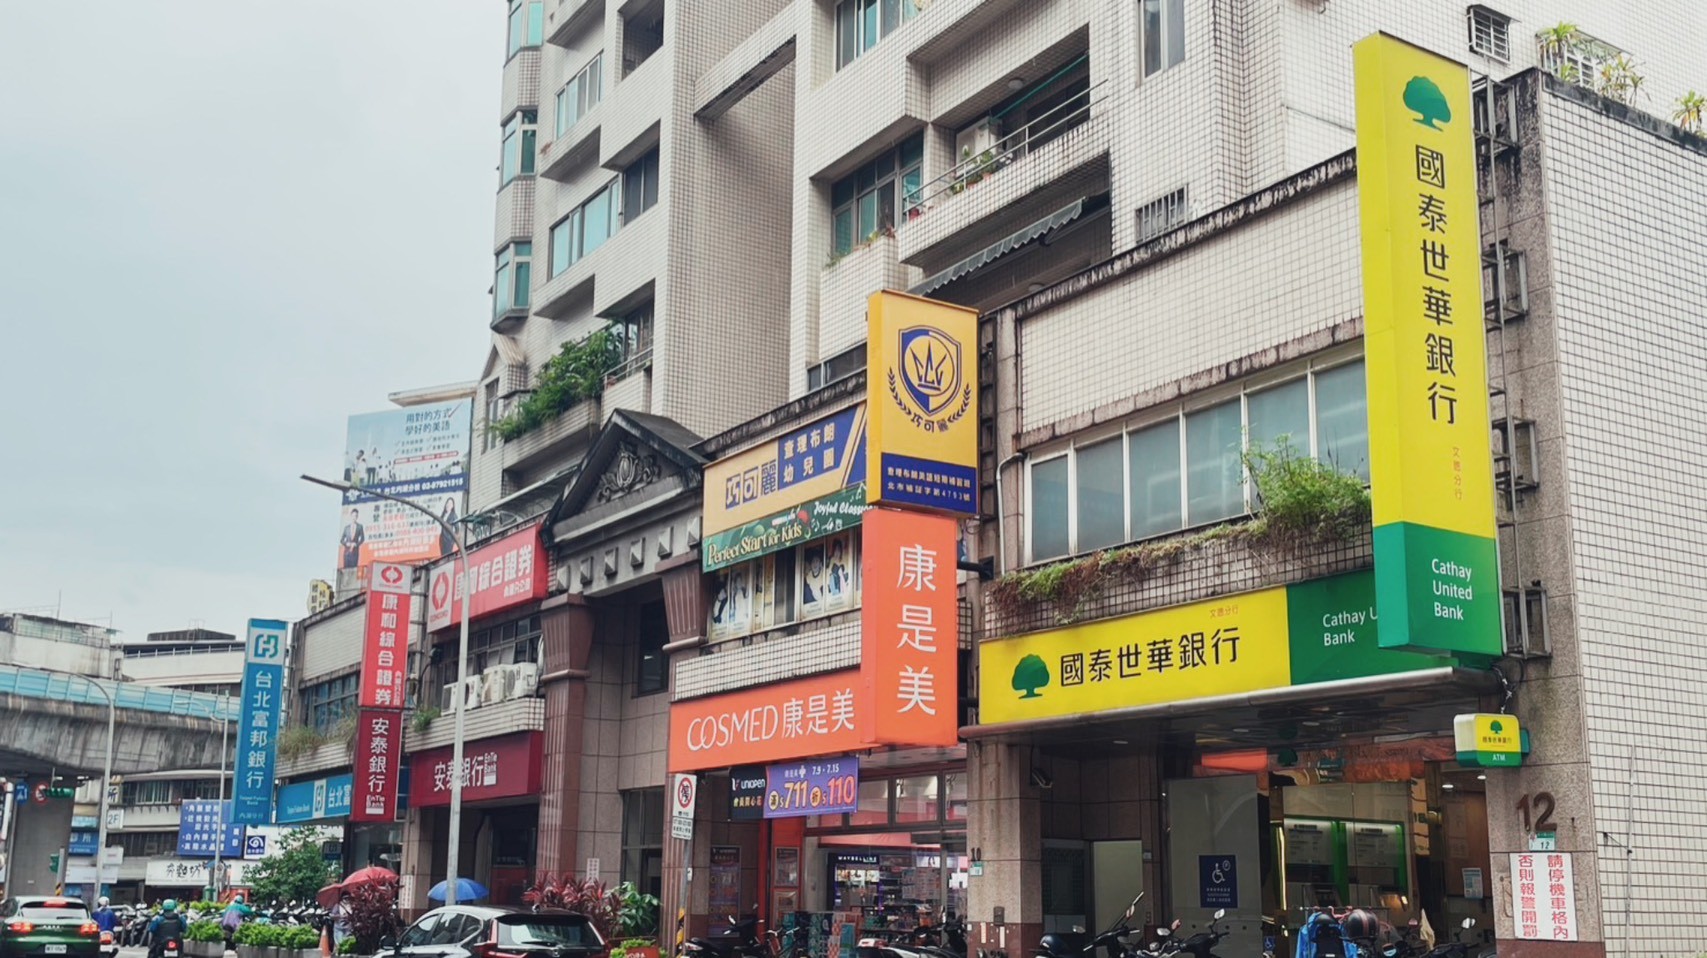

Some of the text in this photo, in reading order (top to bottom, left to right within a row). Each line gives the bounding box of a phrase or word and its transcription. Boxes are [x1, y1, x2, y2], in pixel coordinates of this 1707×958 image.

[1415, 144, 1457, 425] 國泰世華銀行
[784, 422, 835, 460] 查理布朗
[726, 459, 776, 509] 巧可麗
[708, 523, 802, 567] Perfect Start for Kids
[1431, 558, 1472, 582] Cathay
[1432, 580, 1473, 600] United
[897, 543, 937, 716] 康是美
[1322, 607, 1366, 627] Cathay
[1434, 602, 1464, 620] Bank
[1060, 627, 1240, 687] 國泰世華銀行
[1323, 629, 1355, 646] Bank
[246, 670, 273, 790] 台北富邦銀行
[687, 688, 855, 751] COSMED 康是美
[368, 717, 389, 793] 安泰銀行
[1492, 753, 1506, 761] ATM
[108, 814, 119, 825] 2F
[1516, 792, 1557, 832] 12
[970, 847, 982, 861] 10
[1518, 854, 1538, 938] 否則報警開罰
[1547, 854, 1569, 940] 請停機車格內
